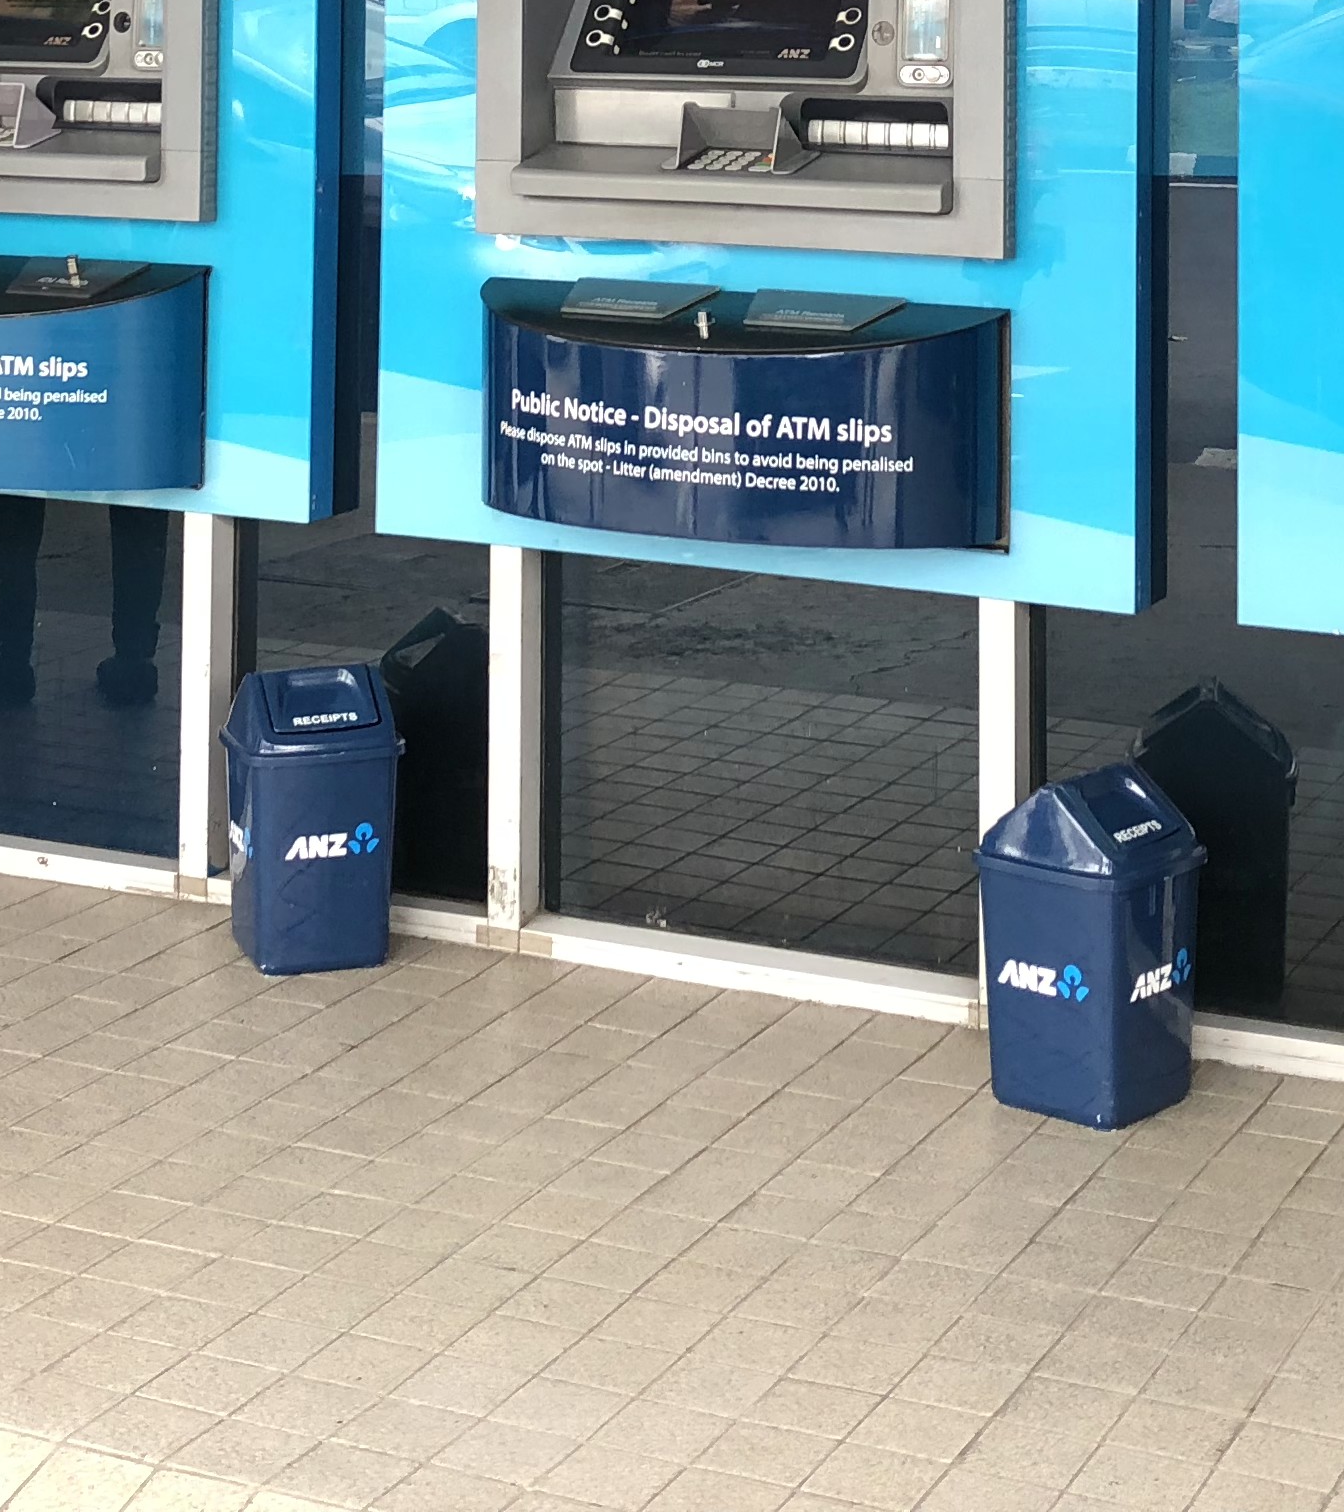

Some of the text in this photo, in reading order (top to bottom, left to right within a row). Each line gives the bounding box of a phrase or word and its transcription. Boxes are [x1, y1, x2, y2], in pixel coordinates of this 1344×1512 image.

[44, 36, 72, 46] ANZ
[777, 48, 811, 59] ANZ
[38, 356, 88, 382] slips
[4, 388, 41, 405] being
[43, 389, 107, 405] penalised
[7, 407, 43, 421] 2010.
[511, 388, 892, 448] Public Notice Disposal of ATM slips
[500, 420, 913, 475] Please dispose ATM slips in provided bins to avoid being penalised
[541, 452, 840, 493] on the spot Litter (amendment) Decree 2010.
[292, 711, 358, 727] RECEIPTS
[1112, 818, 1163, 844] RECEIPTS
[284, 831, 349, 862] ANZ
[997, 959, 1057, 997] ANZ
[1129, 962, 1173, 1004] ANZ
